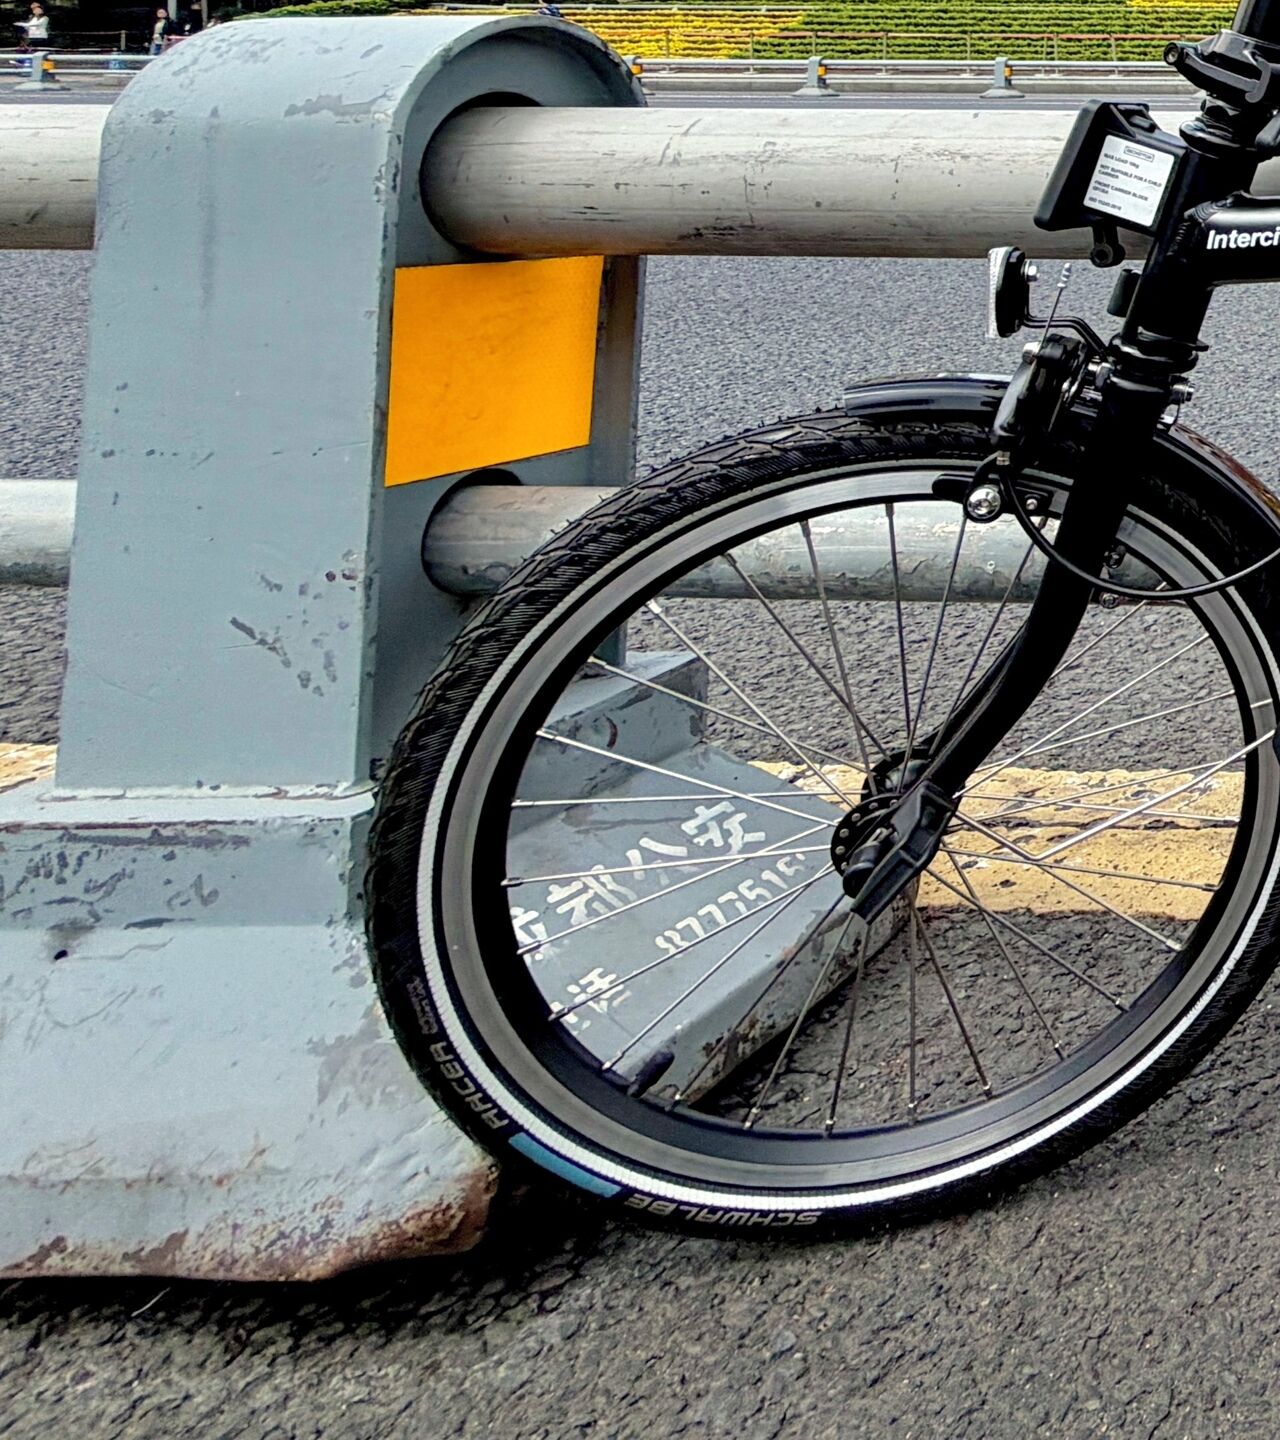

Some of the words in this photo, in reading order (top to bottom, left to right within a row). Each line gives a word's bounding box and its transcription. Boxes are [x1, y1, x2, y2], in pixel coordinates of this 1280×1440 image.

[654, 852, 807, 960] 8777515
[429, 1040, 510, 1130] RACER
[622, 1192, 823, 1227] SCHWALBE
